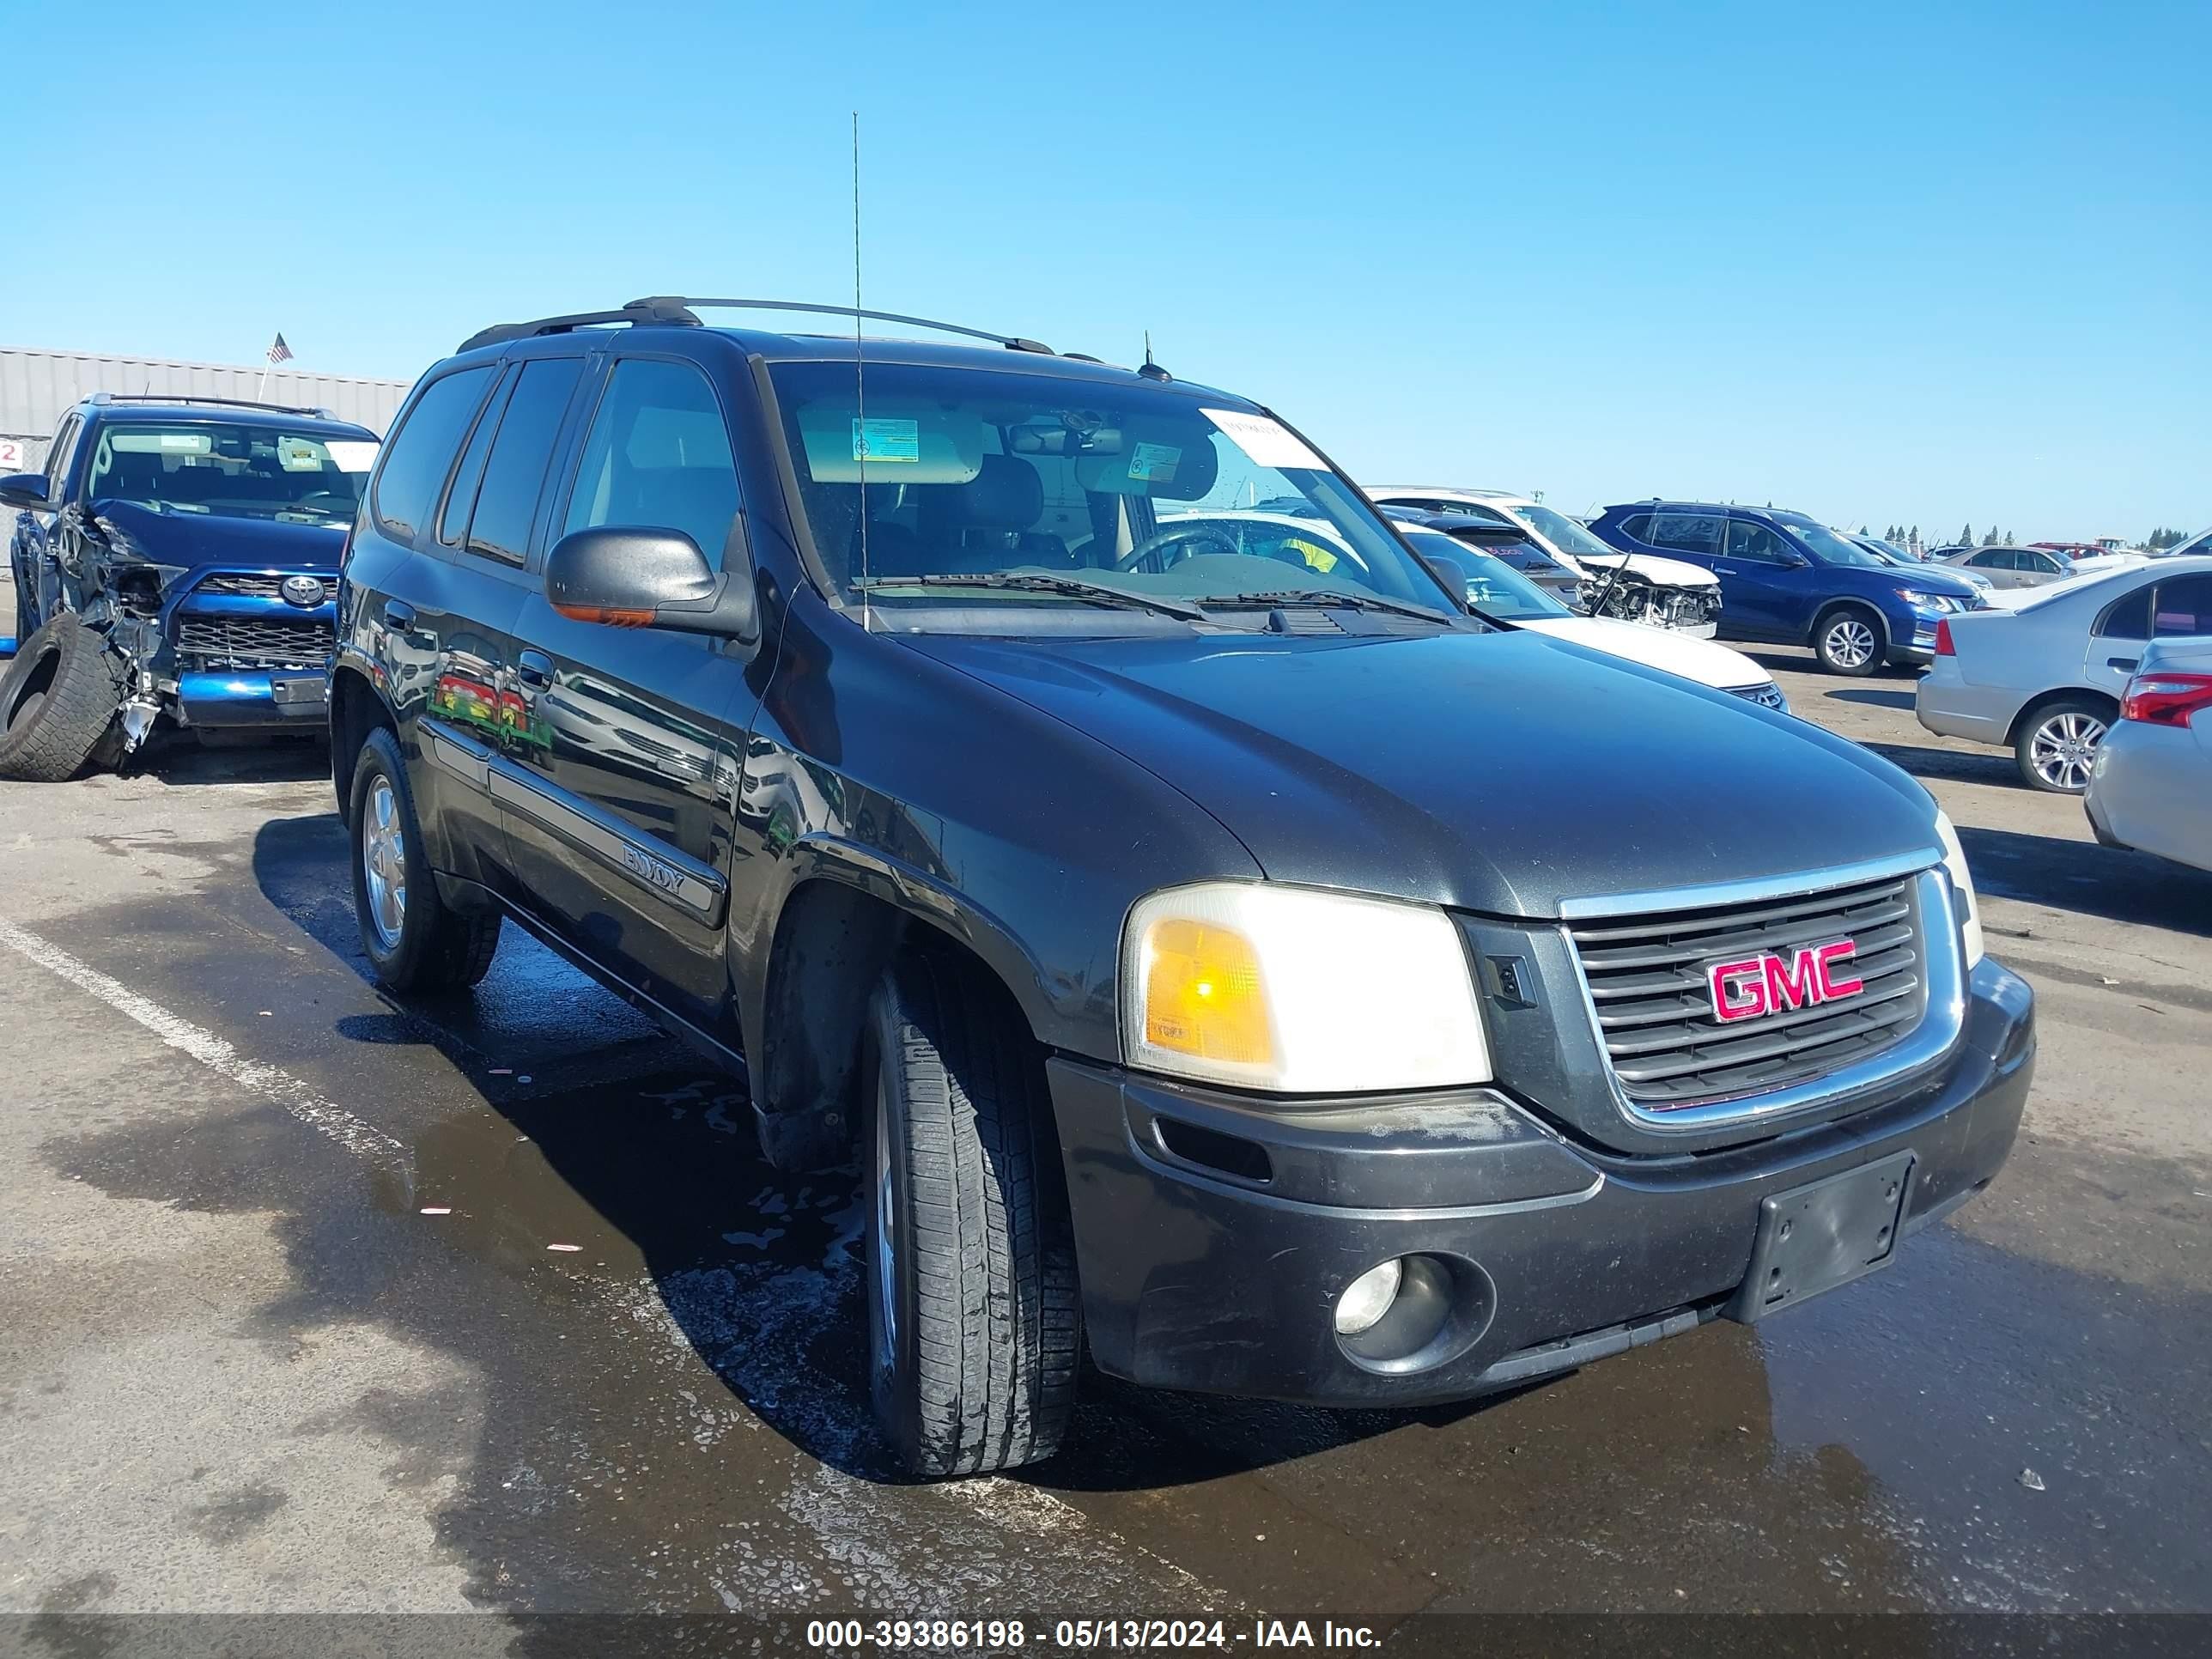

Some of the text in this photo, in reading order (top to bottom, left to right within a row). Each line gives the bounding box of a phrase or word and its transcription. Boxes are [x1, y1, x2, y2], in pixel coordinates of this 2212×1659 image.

[2, 444, 15, 460] 2
[623, 842, 684, 894] ENVOY
[1706, 939, 1863, 1024] GMC
